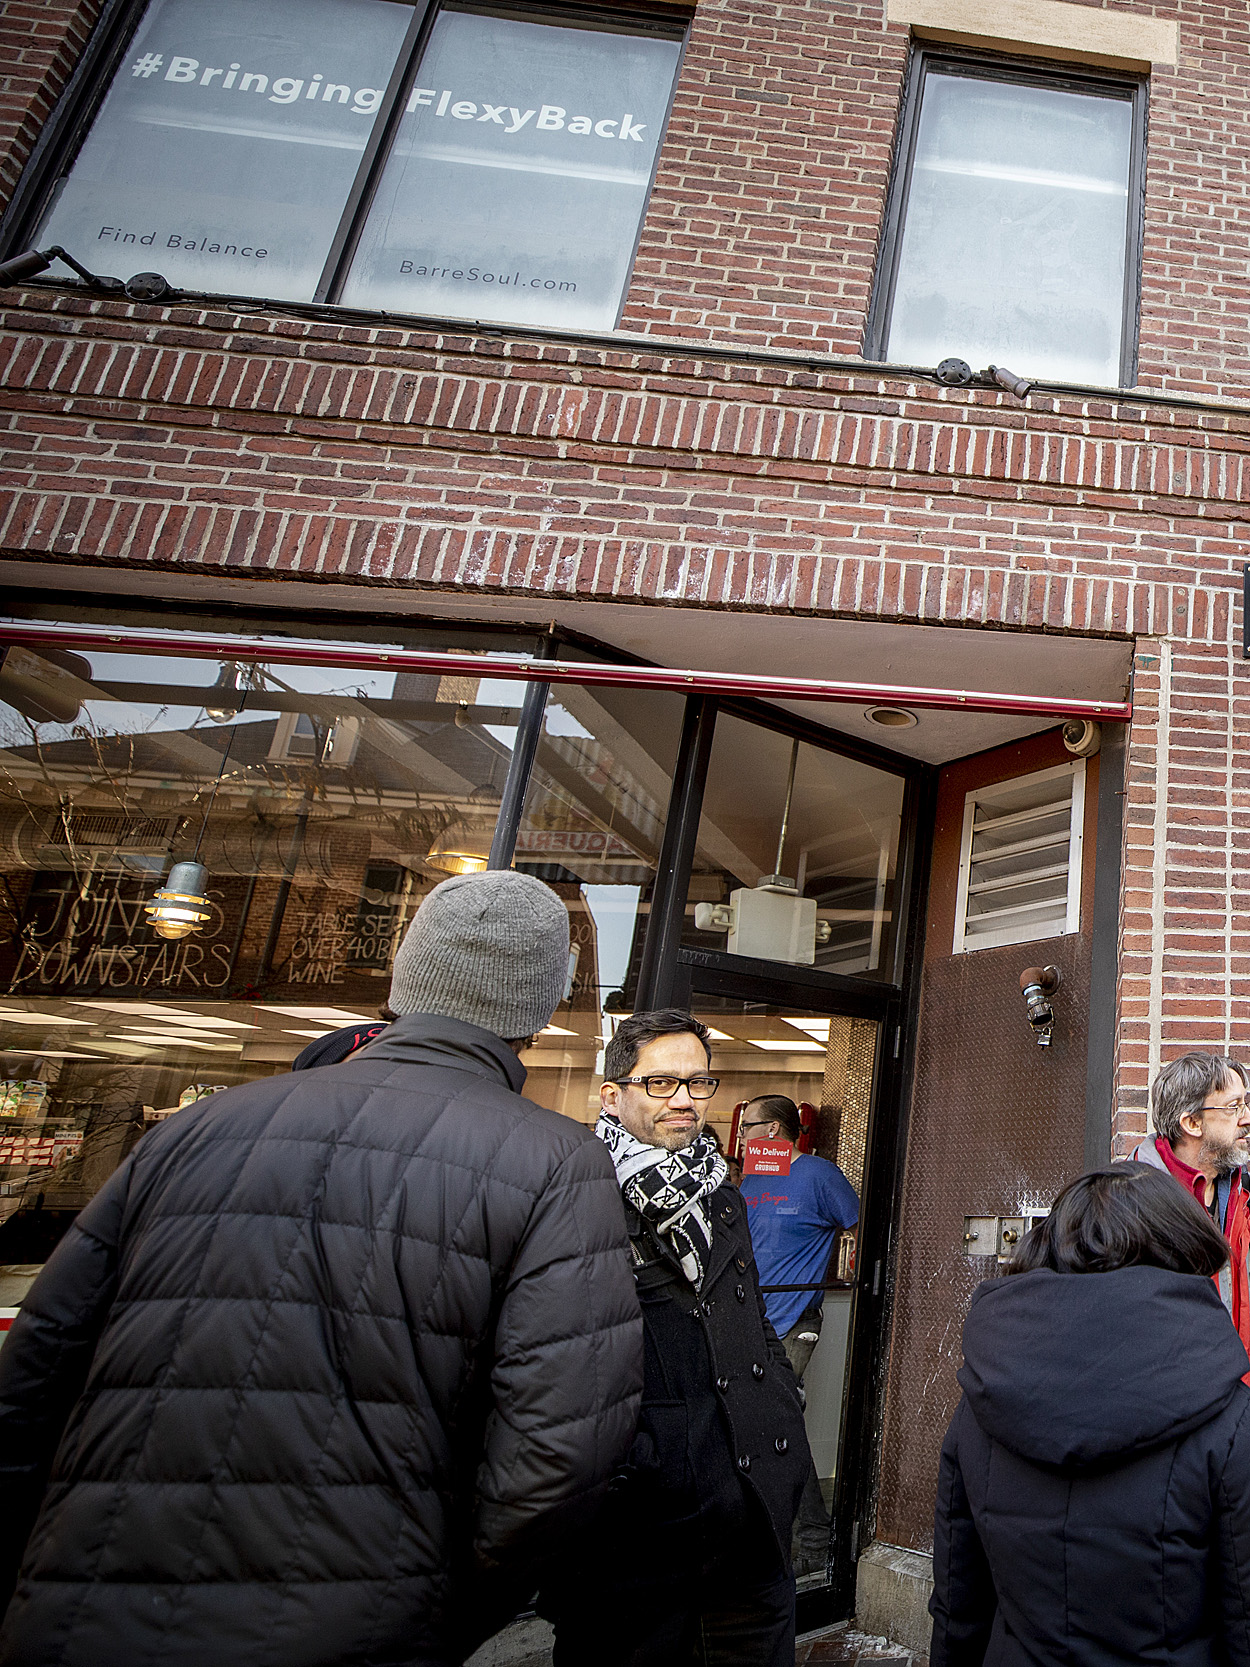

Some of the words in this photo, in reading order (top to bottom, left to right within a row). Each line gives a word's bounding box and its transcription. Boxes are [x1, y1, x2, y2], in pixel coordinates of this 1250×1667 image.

[131, 52, 385, 115] #Bringing
[405, 88, 648, 142] FlexyBack
[97, 226, 157, 246] Find
[166, 234, 270, 260] Balance
[399, 260, 578, 292] BarreSoul.com
[33, 888, 147, 939] JOIN
[297, 911, 359, 936] TABLE
[291, 936, 345, 960] OVER
[10, 940, 232, 988] DOWNSTAIRS
[287, 961, 348, 984] WINE
[748, 1146, 761, 1155] We
[762, 1147, 790, 1157] Deliver!
[754, 1163, 780, 1172] GRUBHUB
[760, 1192, 789, 1206] Burger
